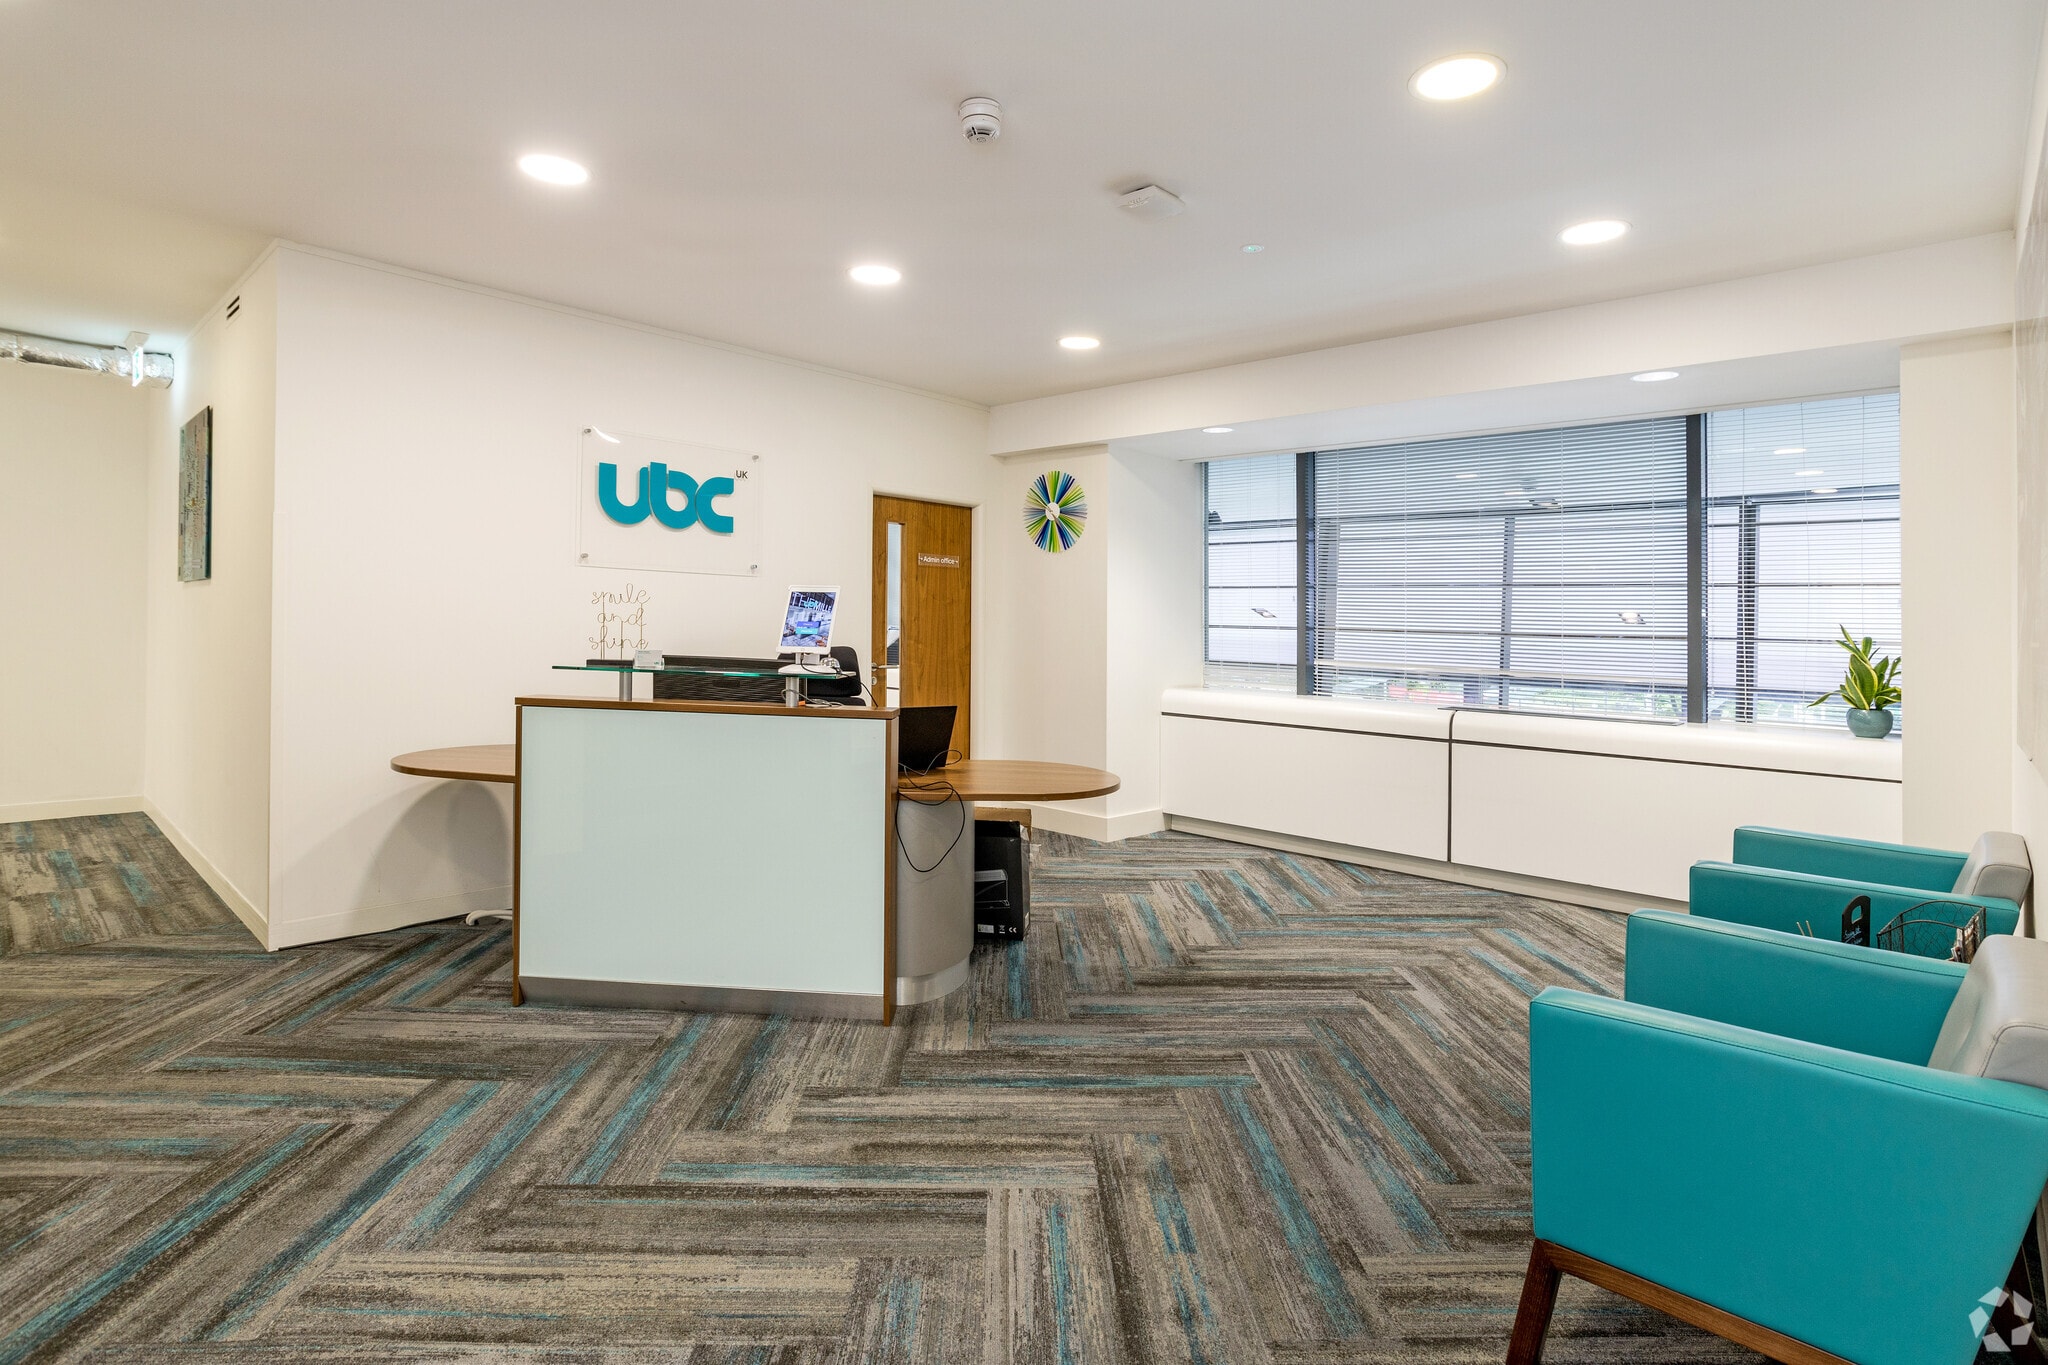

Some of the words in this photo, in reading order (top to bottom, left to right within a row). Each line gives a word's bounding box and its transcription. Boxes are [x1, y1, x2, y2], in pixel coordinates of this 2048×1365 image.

[735, 470, 748, 479] UK
[598, 462, 734, 534] ubc
[940, 557, 955, 565] office
[591, 583, 651, 605] smile
[597, 607, 647, 627] and
[588, 625, 649, 650] shine
